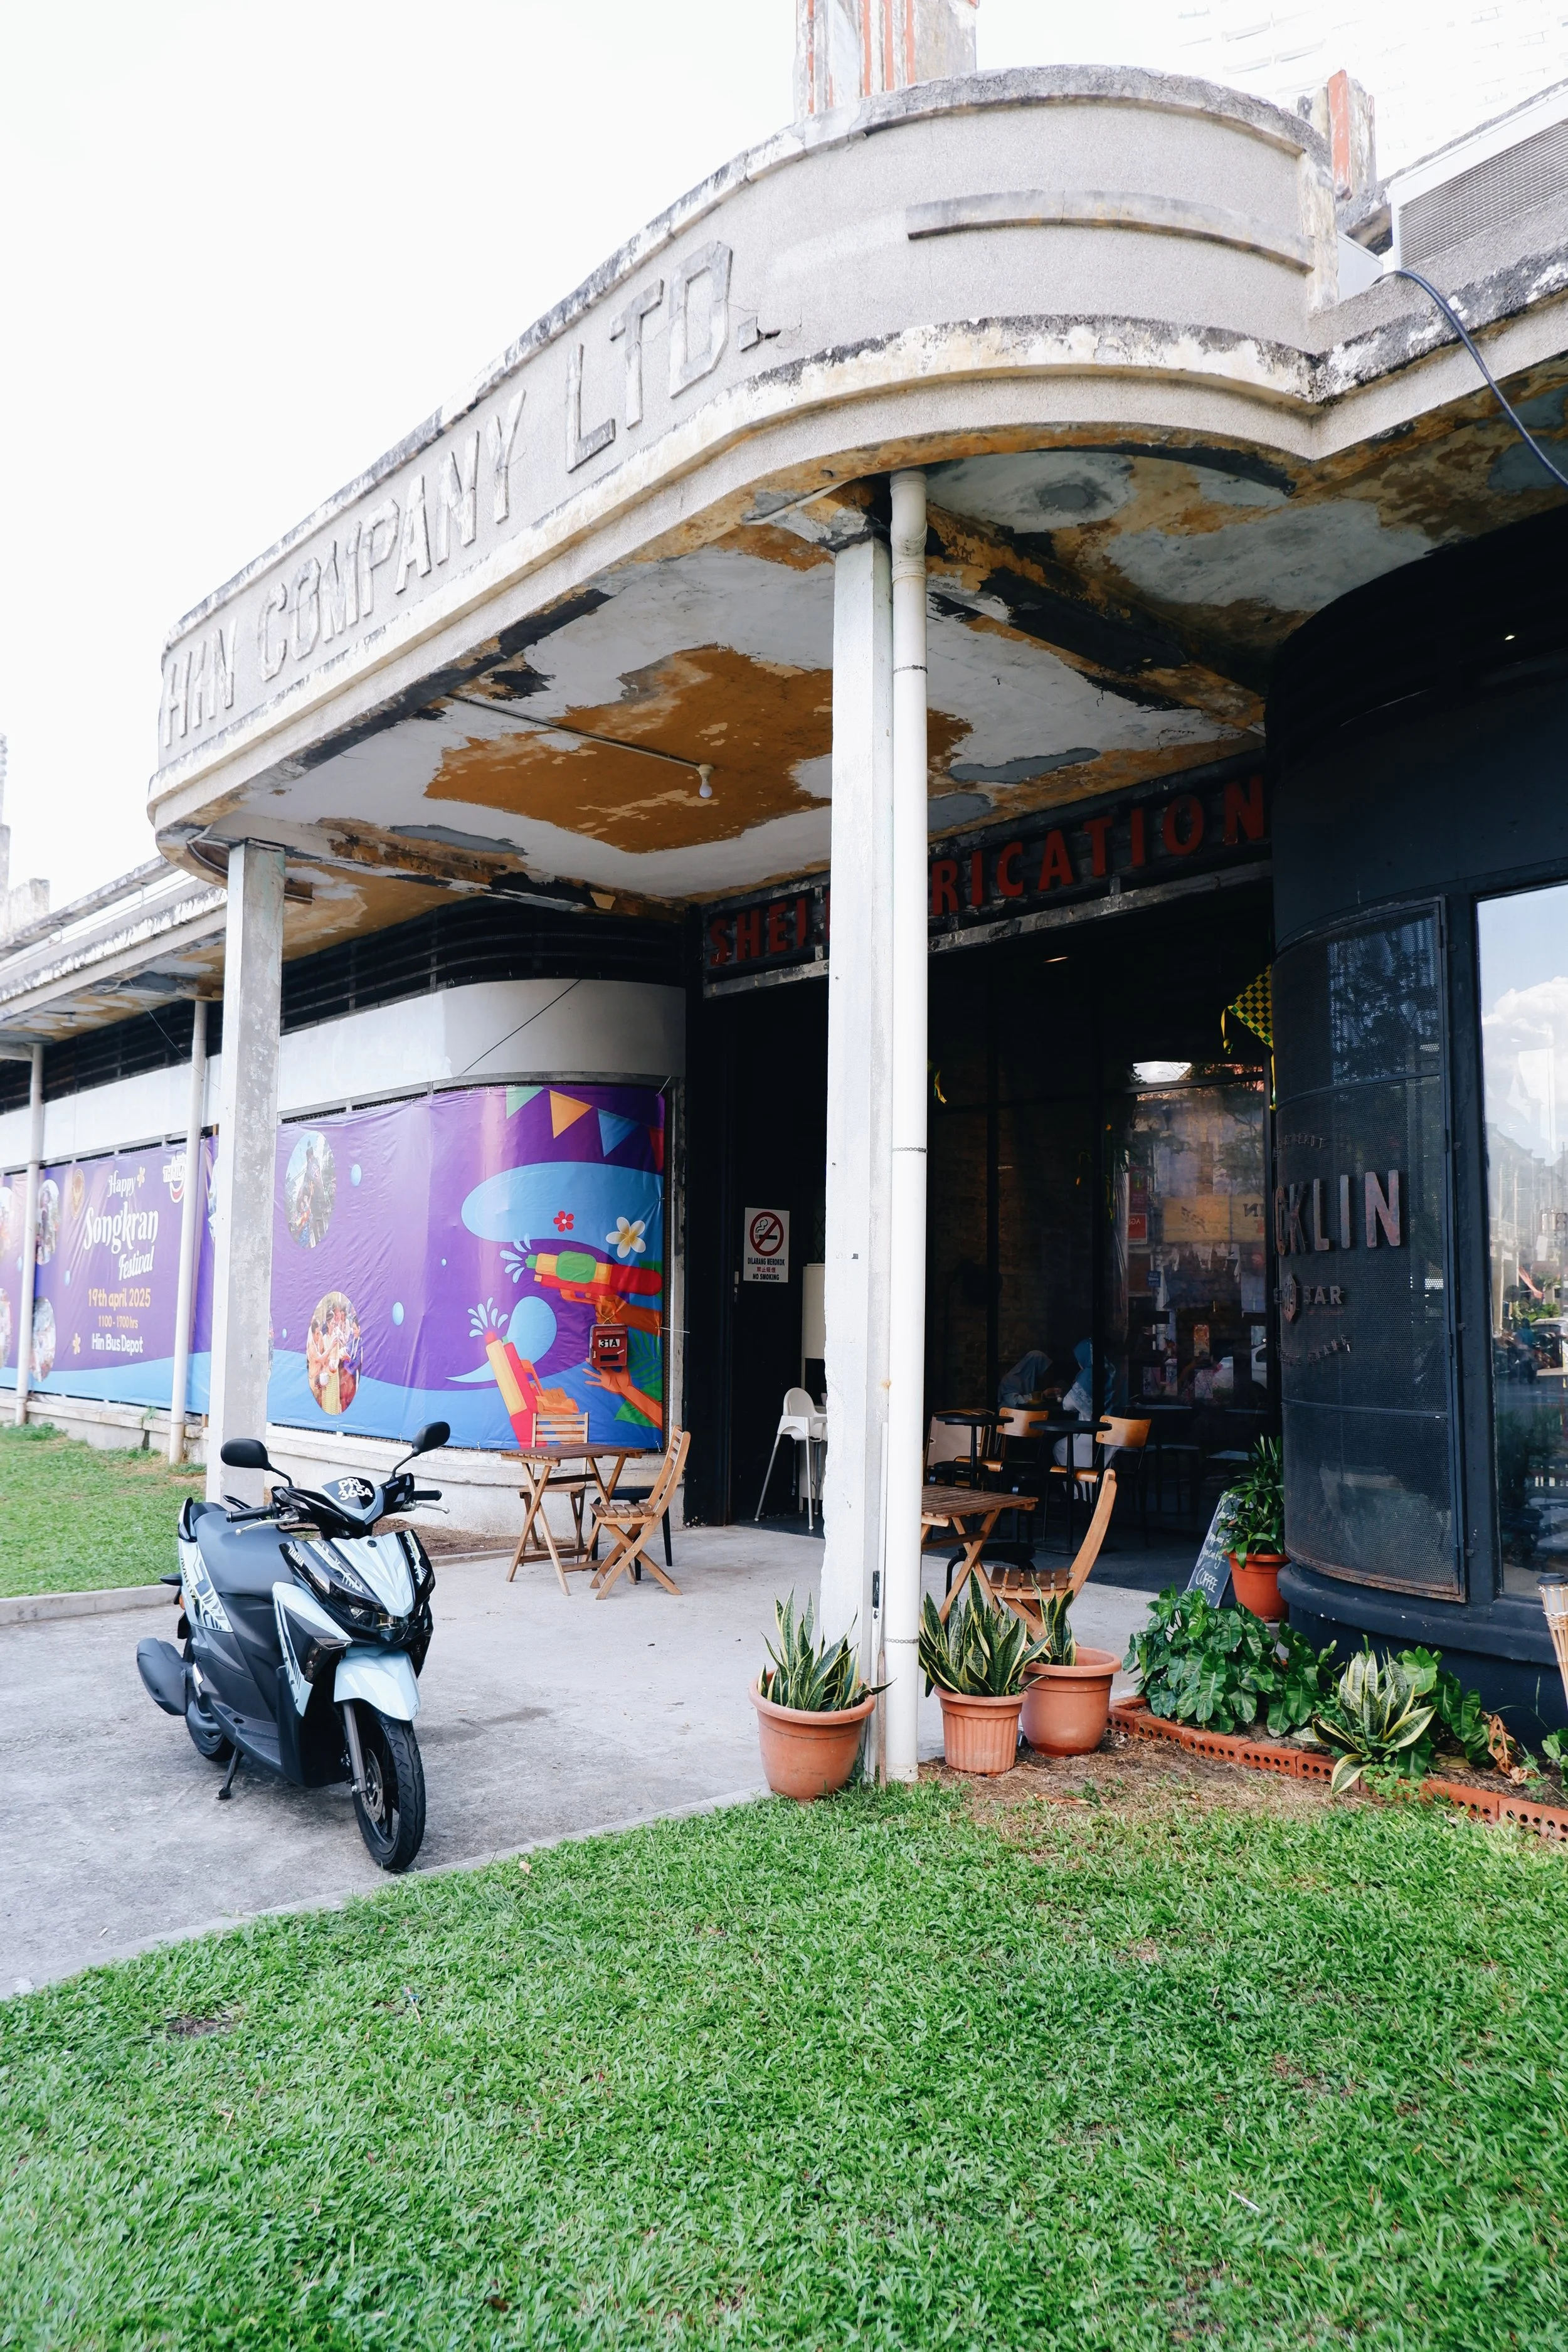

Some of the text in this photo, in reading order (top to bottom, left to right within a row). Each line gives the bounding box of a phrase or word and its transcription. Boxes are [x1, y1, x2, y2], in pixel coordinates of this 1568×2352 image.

[257, 389, 526, 682] COMPANY
[107, 1170, 136, 1198] Happy
[83, 1201, 159, 1254] Songkran
[119, 1245, 155, 1281] Festival
[748, 1257, 785, 1266] DILARANG MEROKOK
[88, 1288, 151, 1311] 19th april 2025
[1303, 1285, 1342, 1305] BAR
[92, 1333, 144, 1356] Hin Bus Depot
[600, 1338, 618, 1348] 31A
[338, 1478, 365, 1491] PRL
[338, 1486, 373, 1501] 3654
[288, 1546, 305, 1567] YAMAHA
[1195, 1567, 1219, 1593] COFFEE
